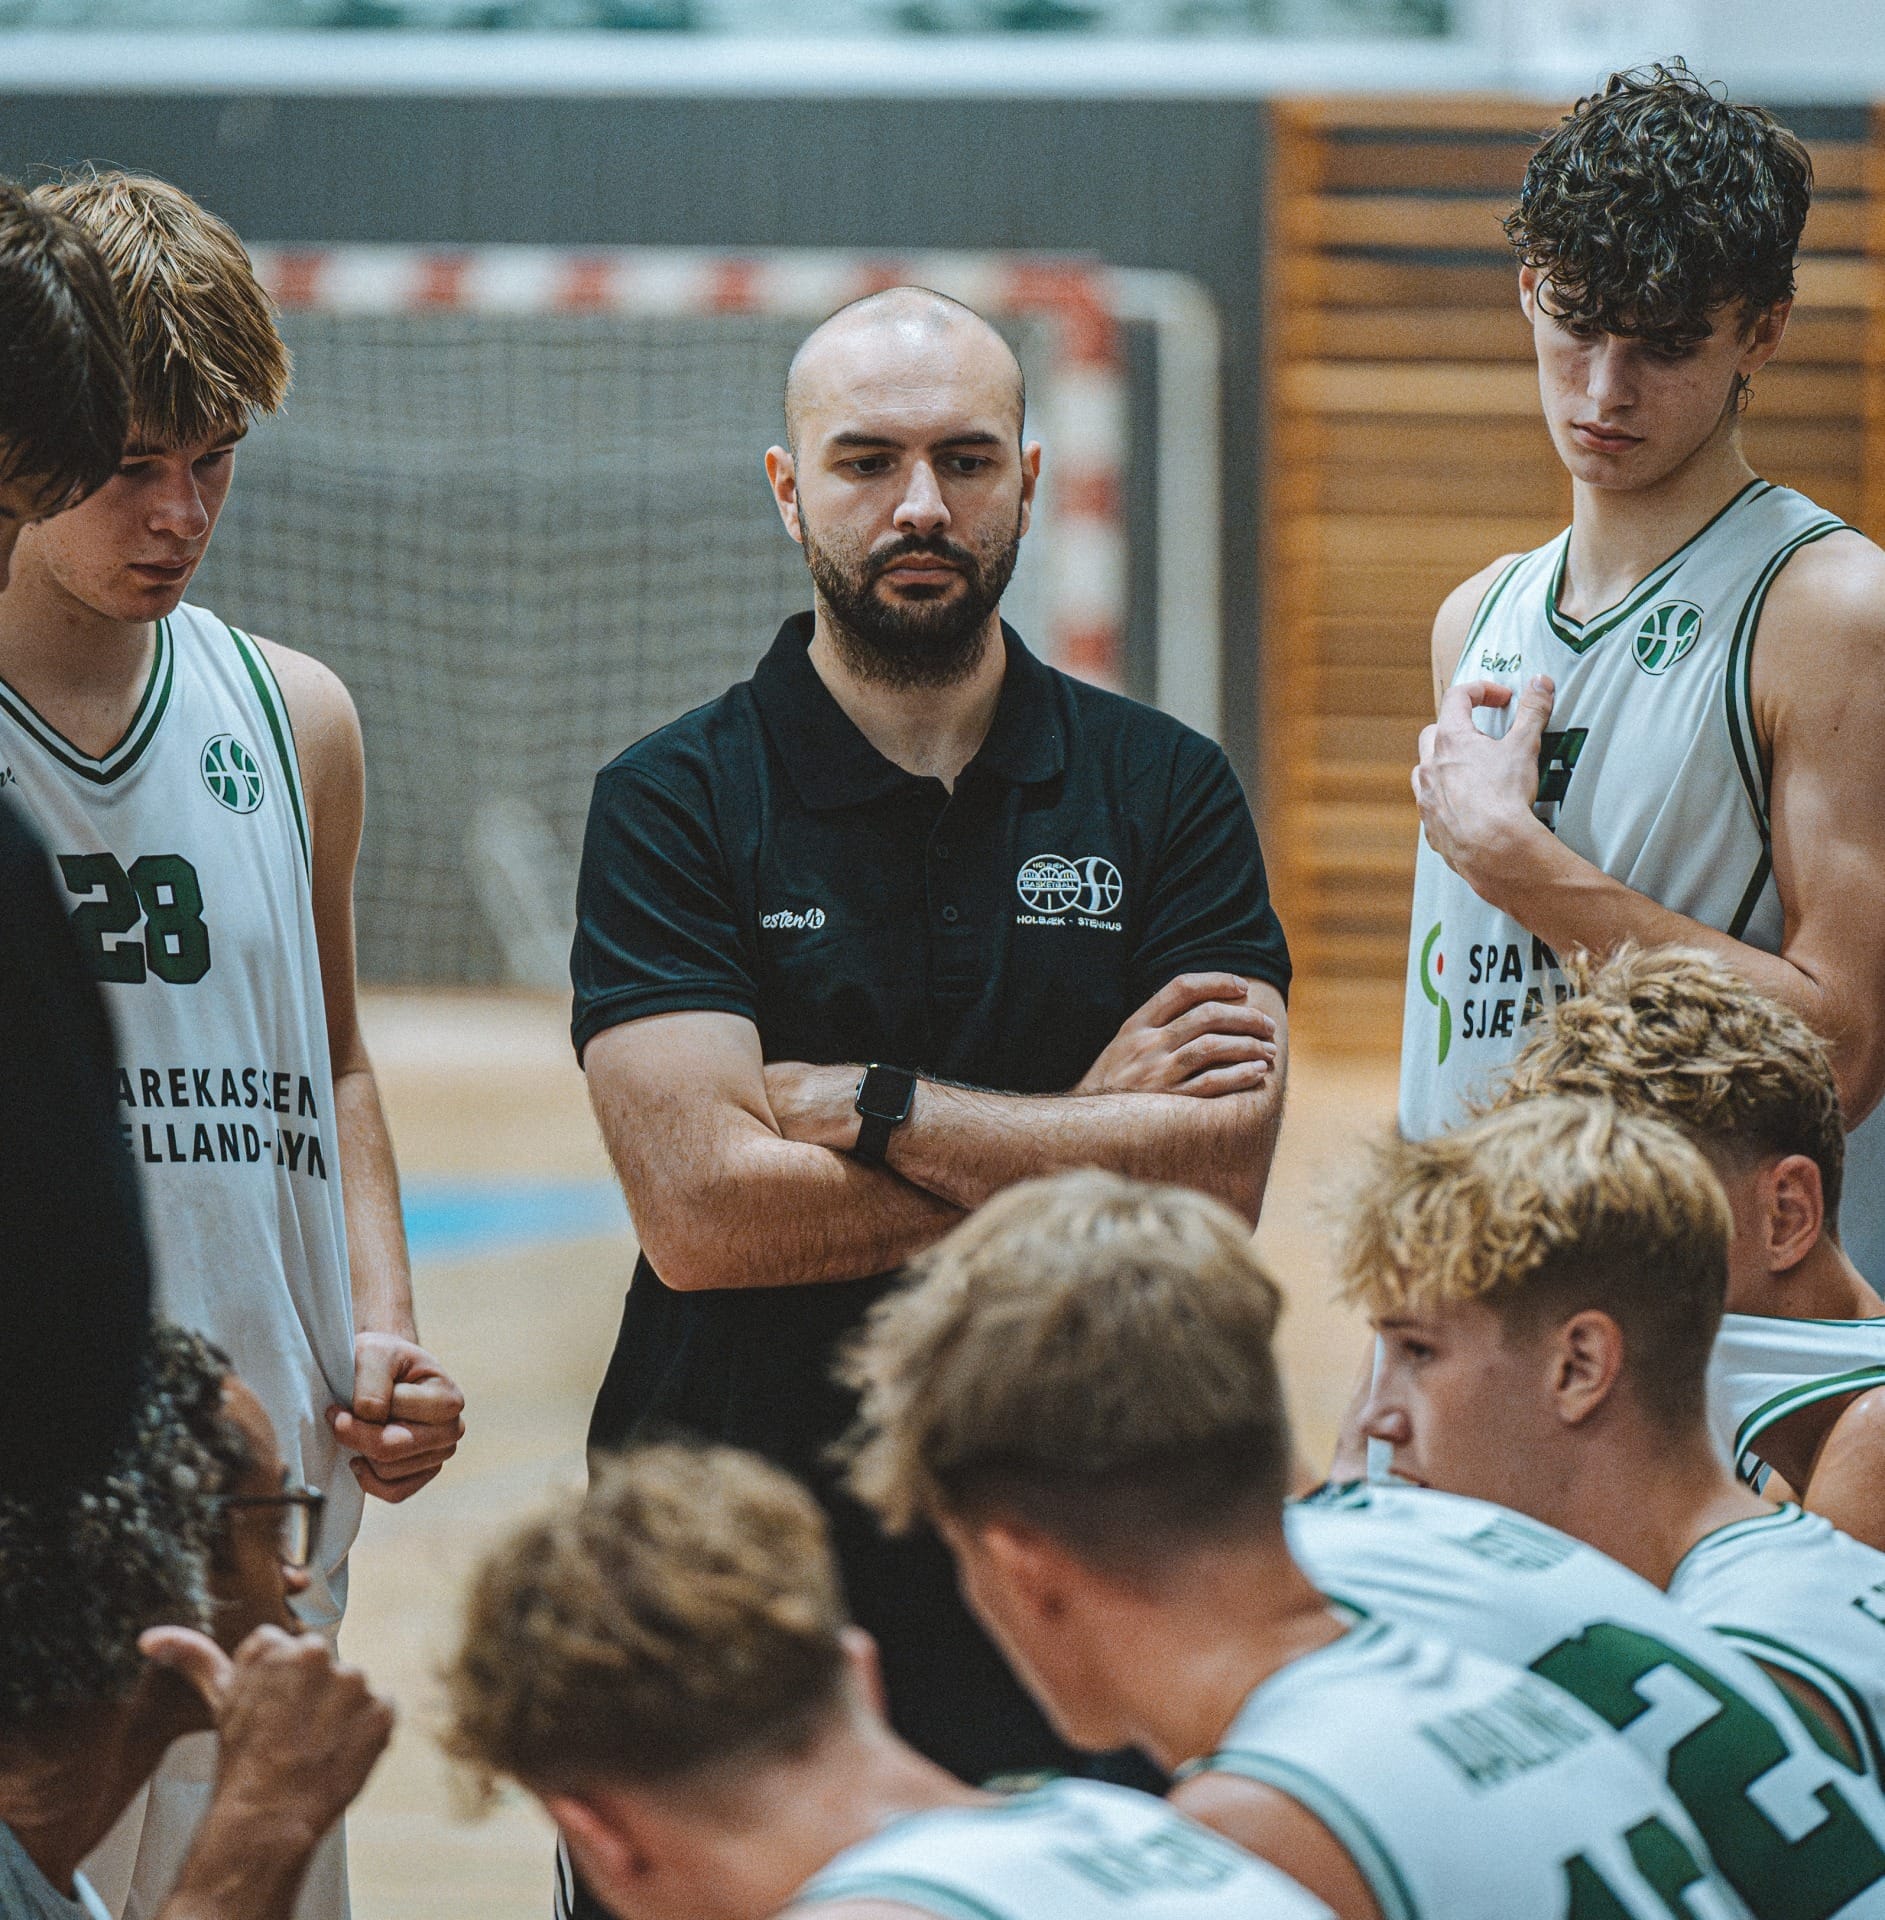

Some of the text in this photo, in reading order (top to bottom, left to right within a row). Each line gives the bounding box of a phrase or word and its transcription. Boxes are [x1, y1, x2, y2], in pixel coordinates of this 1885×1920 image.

[1023, 880, 1076, 888] BASKETBALL
[57, 852, 211, 984] 28
[1016, 914, 1066, 926] HOLBÆK
[1078, 916, 1122, 932] STENHUS
